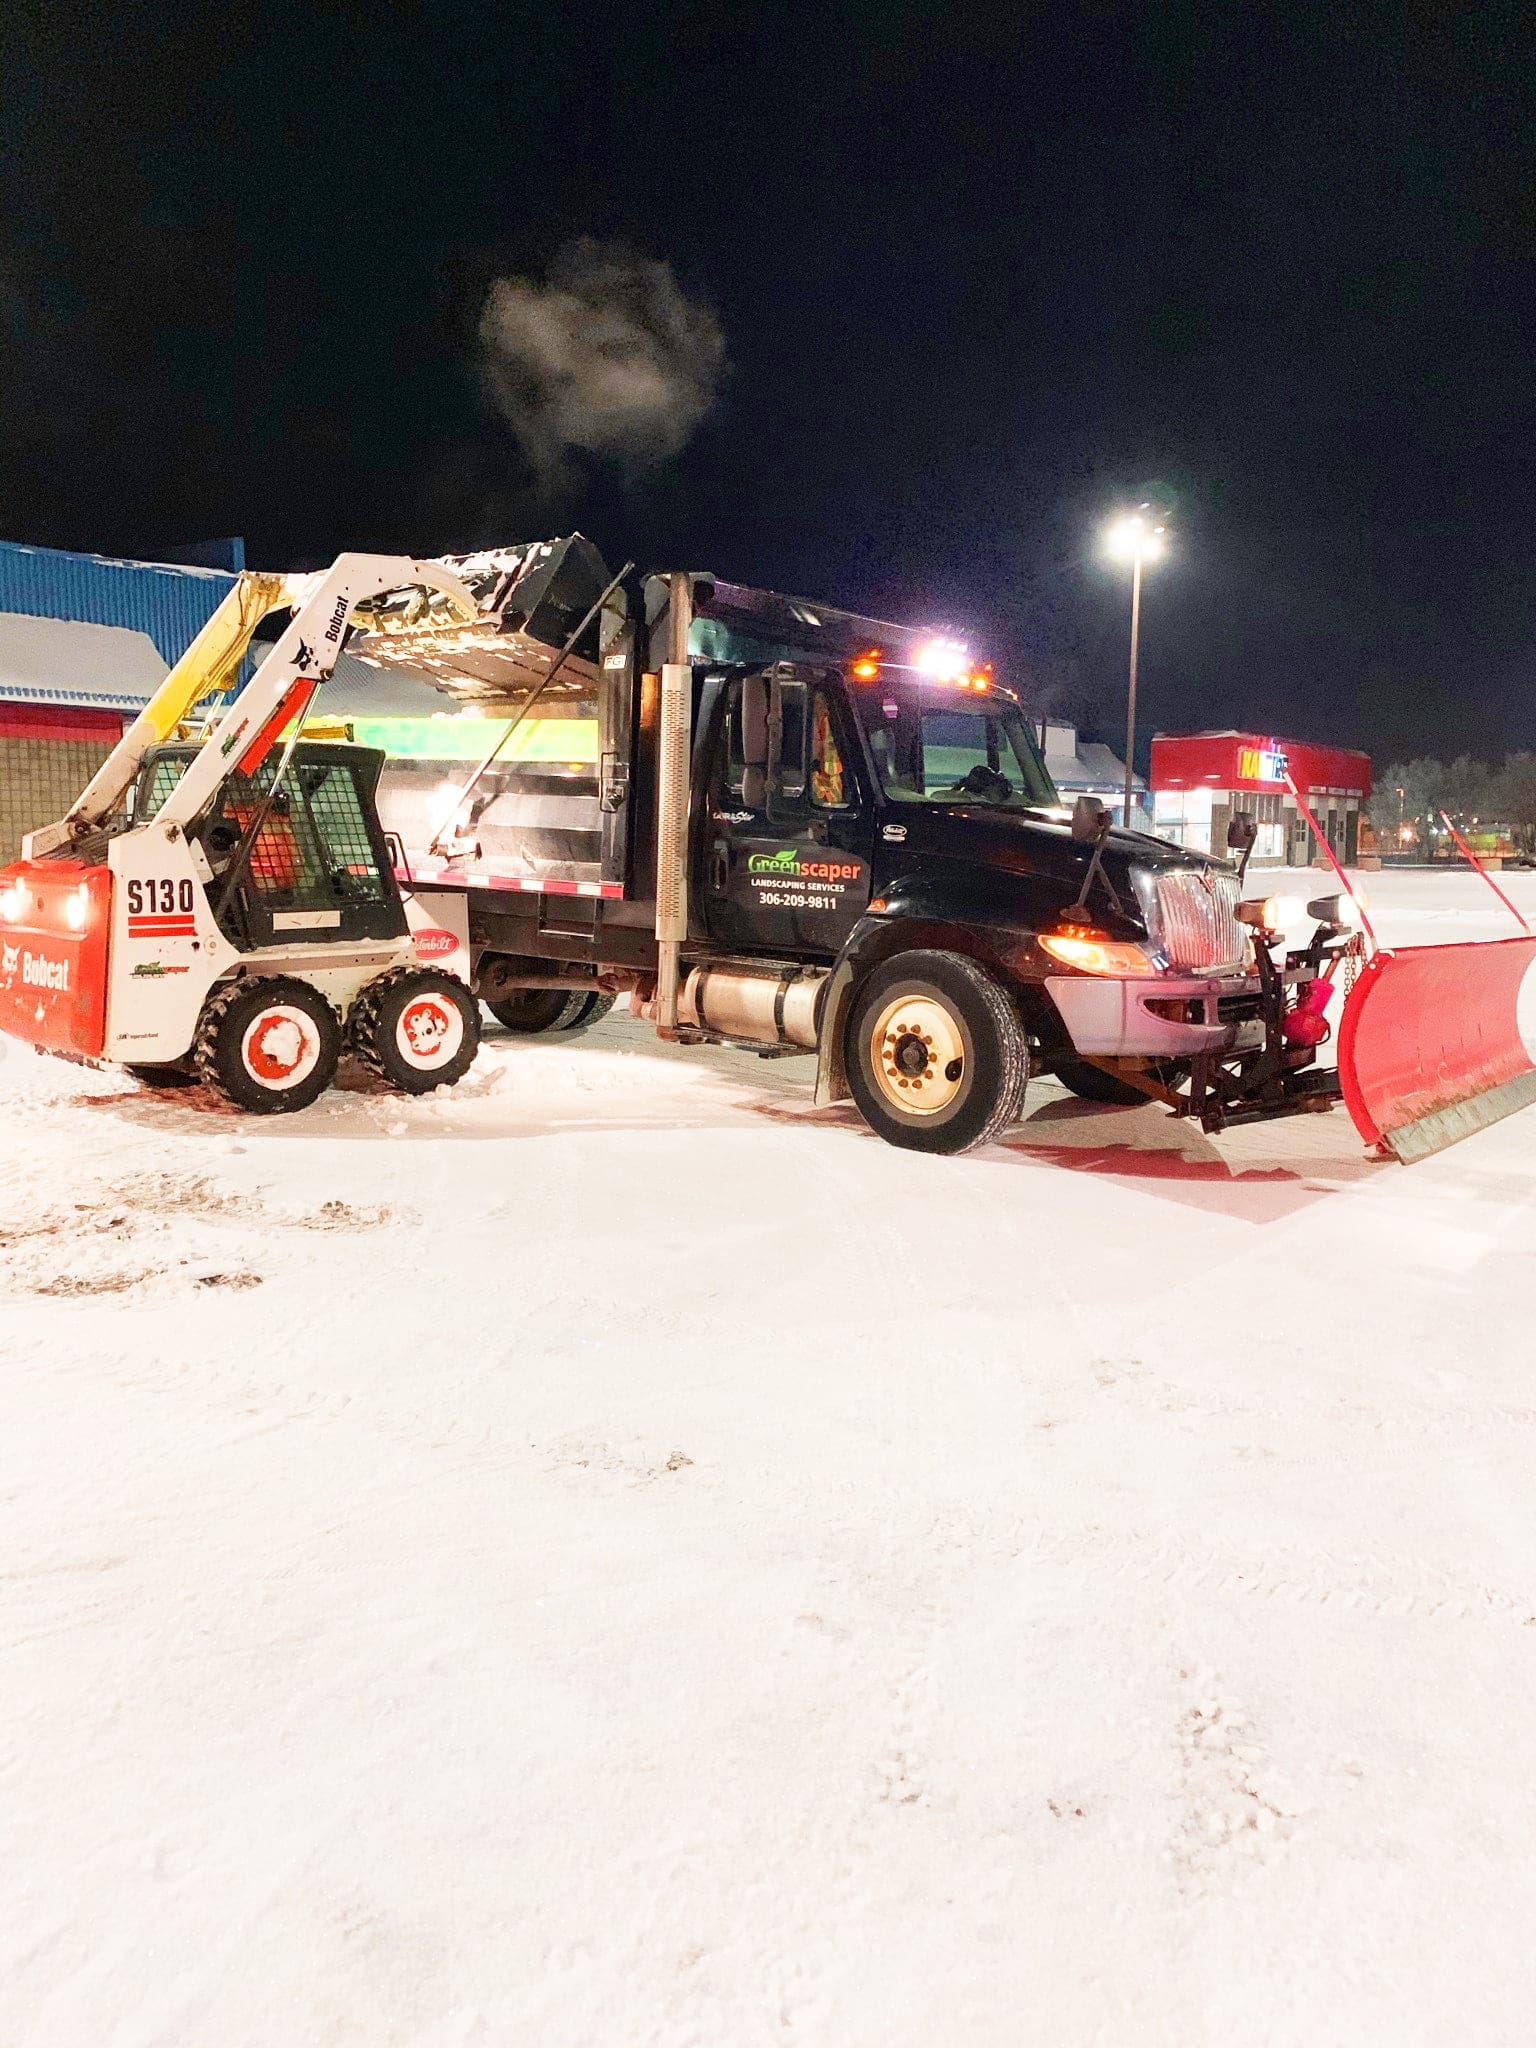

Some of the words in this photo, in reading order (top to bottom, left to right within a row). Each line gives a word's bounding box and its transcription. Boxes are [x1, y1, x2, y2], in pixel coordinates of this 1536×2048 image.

[325, 595, 349, 643] Bobcat
[748, 852, 861, 882] Greenscaper
[127, 879, 194, 914] S130
[751, 878, 805, 890] LANDSCAPING
[807, 882, 845, 893] SERVICES
[759, 892, 837, 910] 306-209-9811
[22, 951, 69, 992] Bobcat
